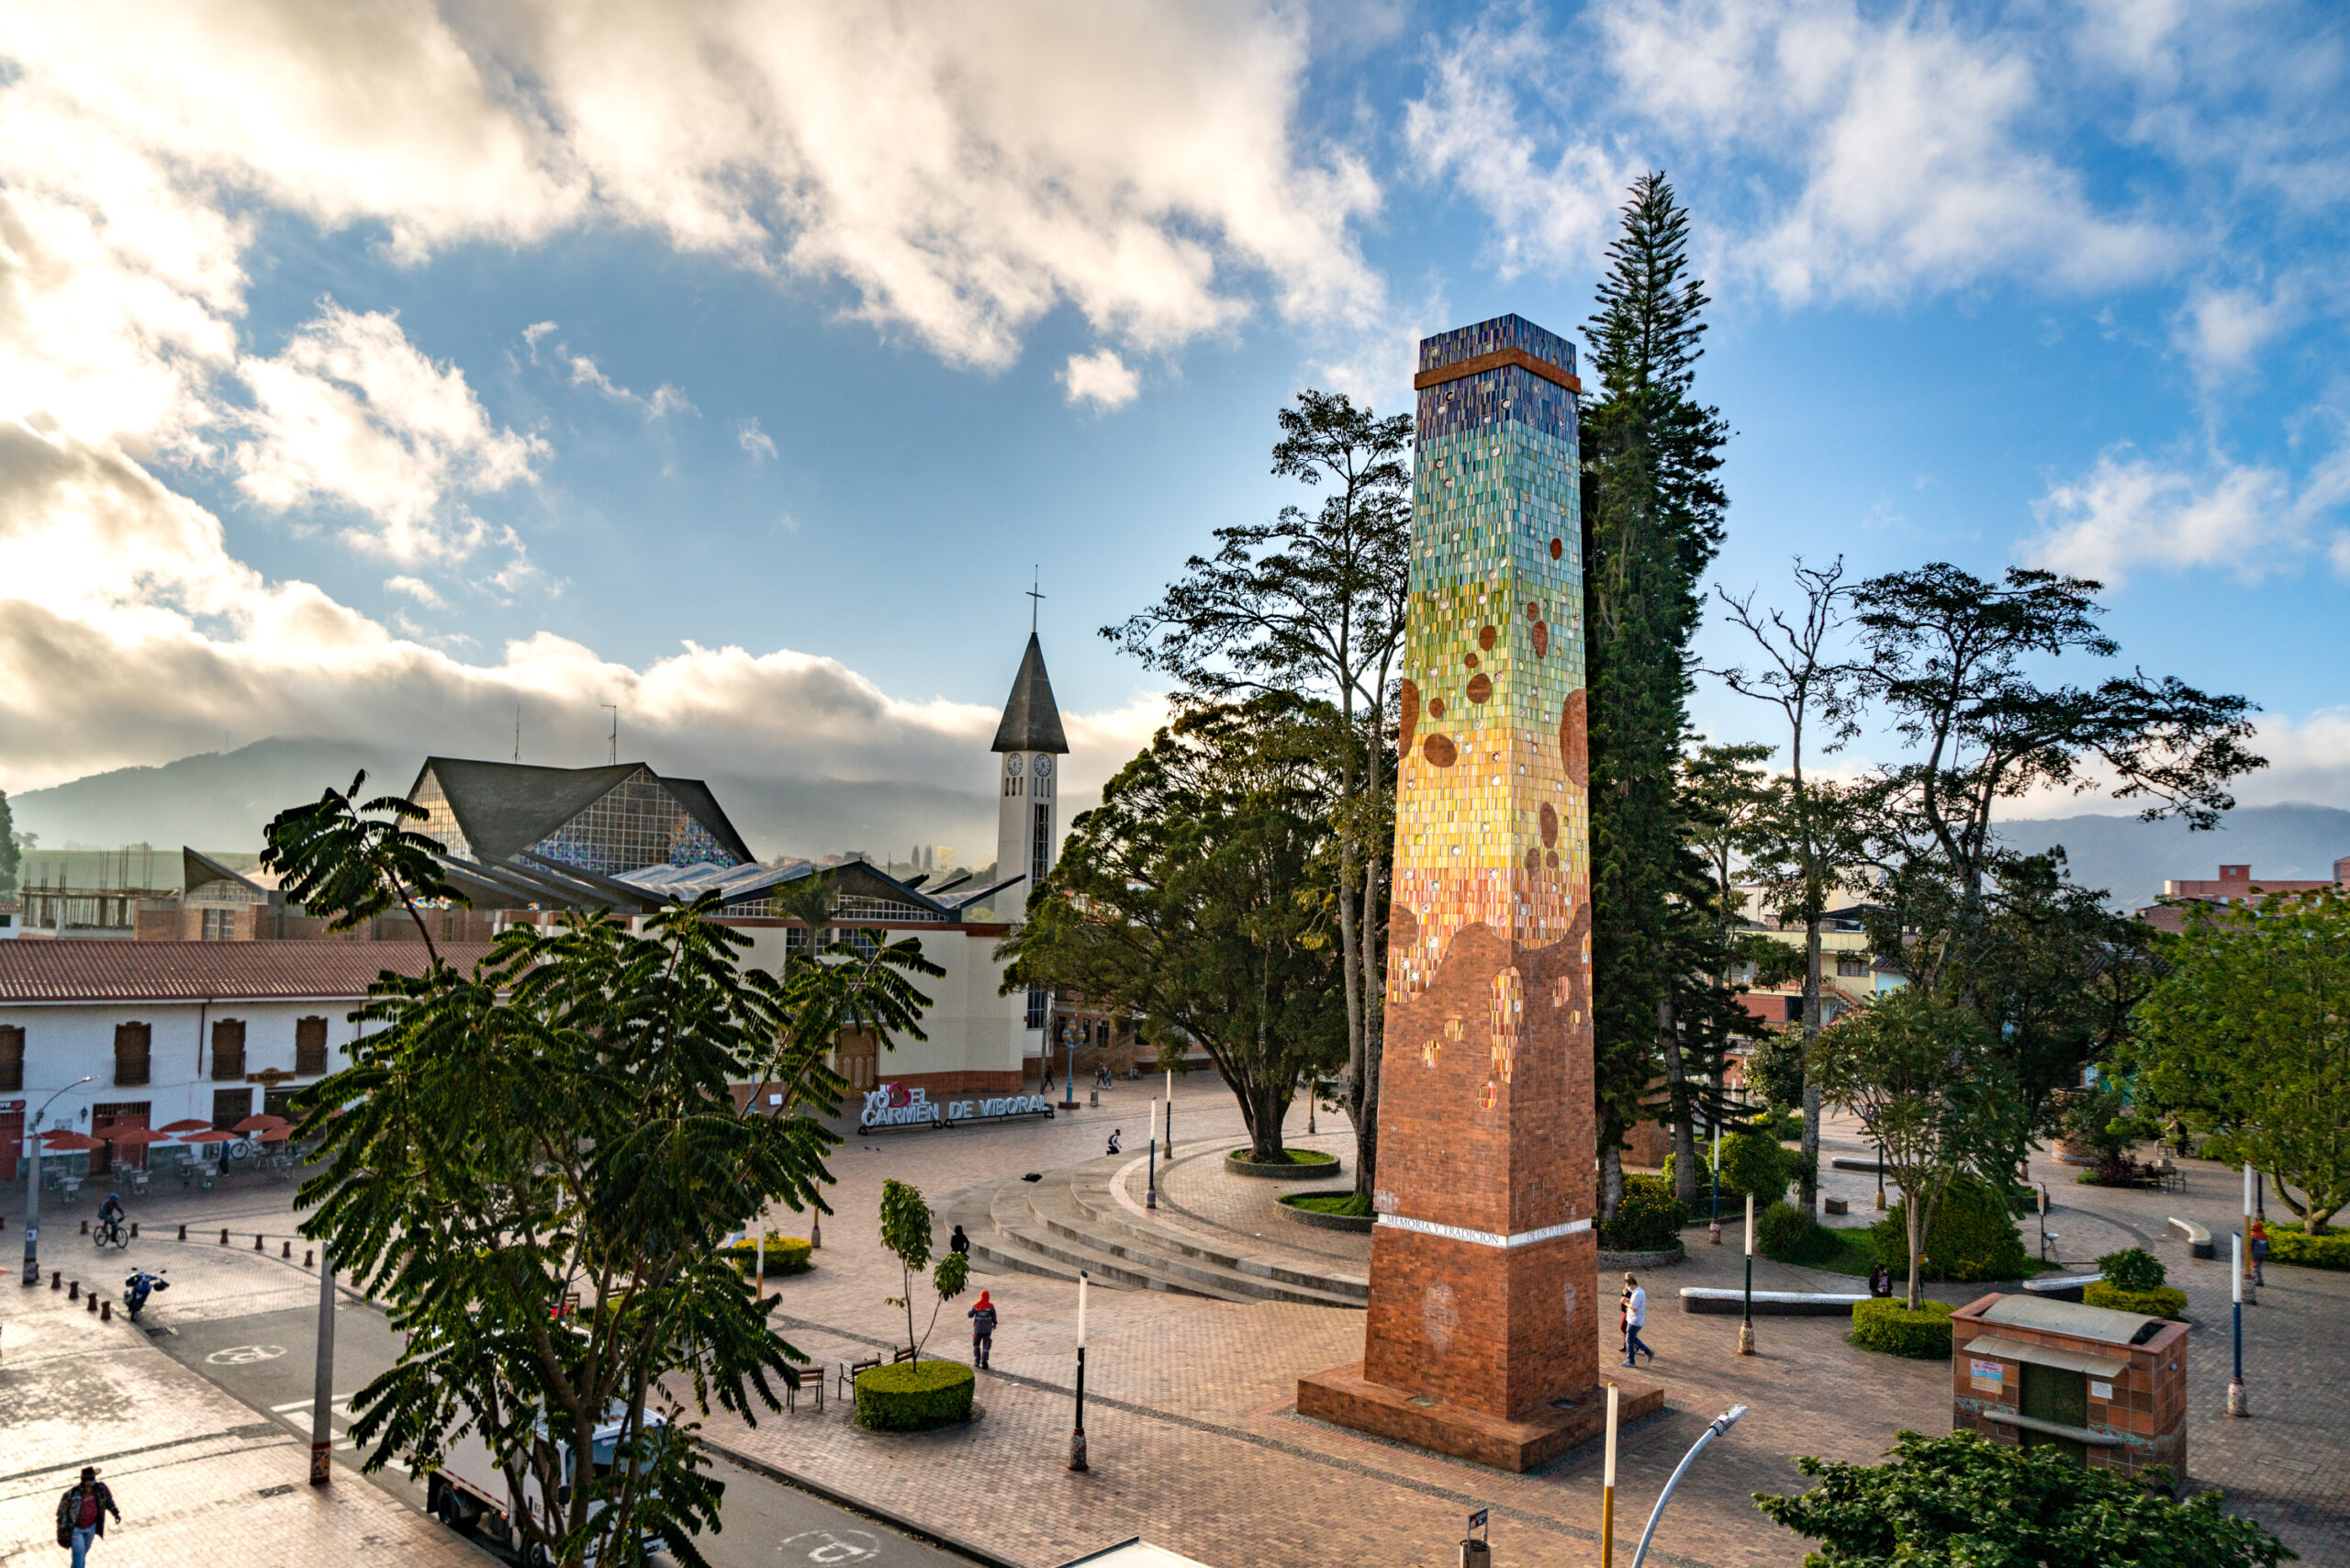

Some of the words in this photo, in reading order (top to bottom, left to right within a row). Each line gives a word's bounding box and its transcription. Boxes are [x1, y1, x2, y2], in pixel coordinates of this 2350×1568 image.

[861, 1103, 939, 1126] CARMEN
[948, 1101, 973, 1119] DE
[979, 1094, 1050, 1116] VIBORAL
[863, 1091, 890, 1109] YO
[909, 1088, 931, 1106] EL
[1386, 1215, 1431, 1230] MEMORIA
[1433, 1223, 1442, 1233] Y
[1443, 1225, 1499, 1244] TRADICION
[1527, 1231, 1536, 1242] DE
[1538, 1228, 1548, 1239] UN
